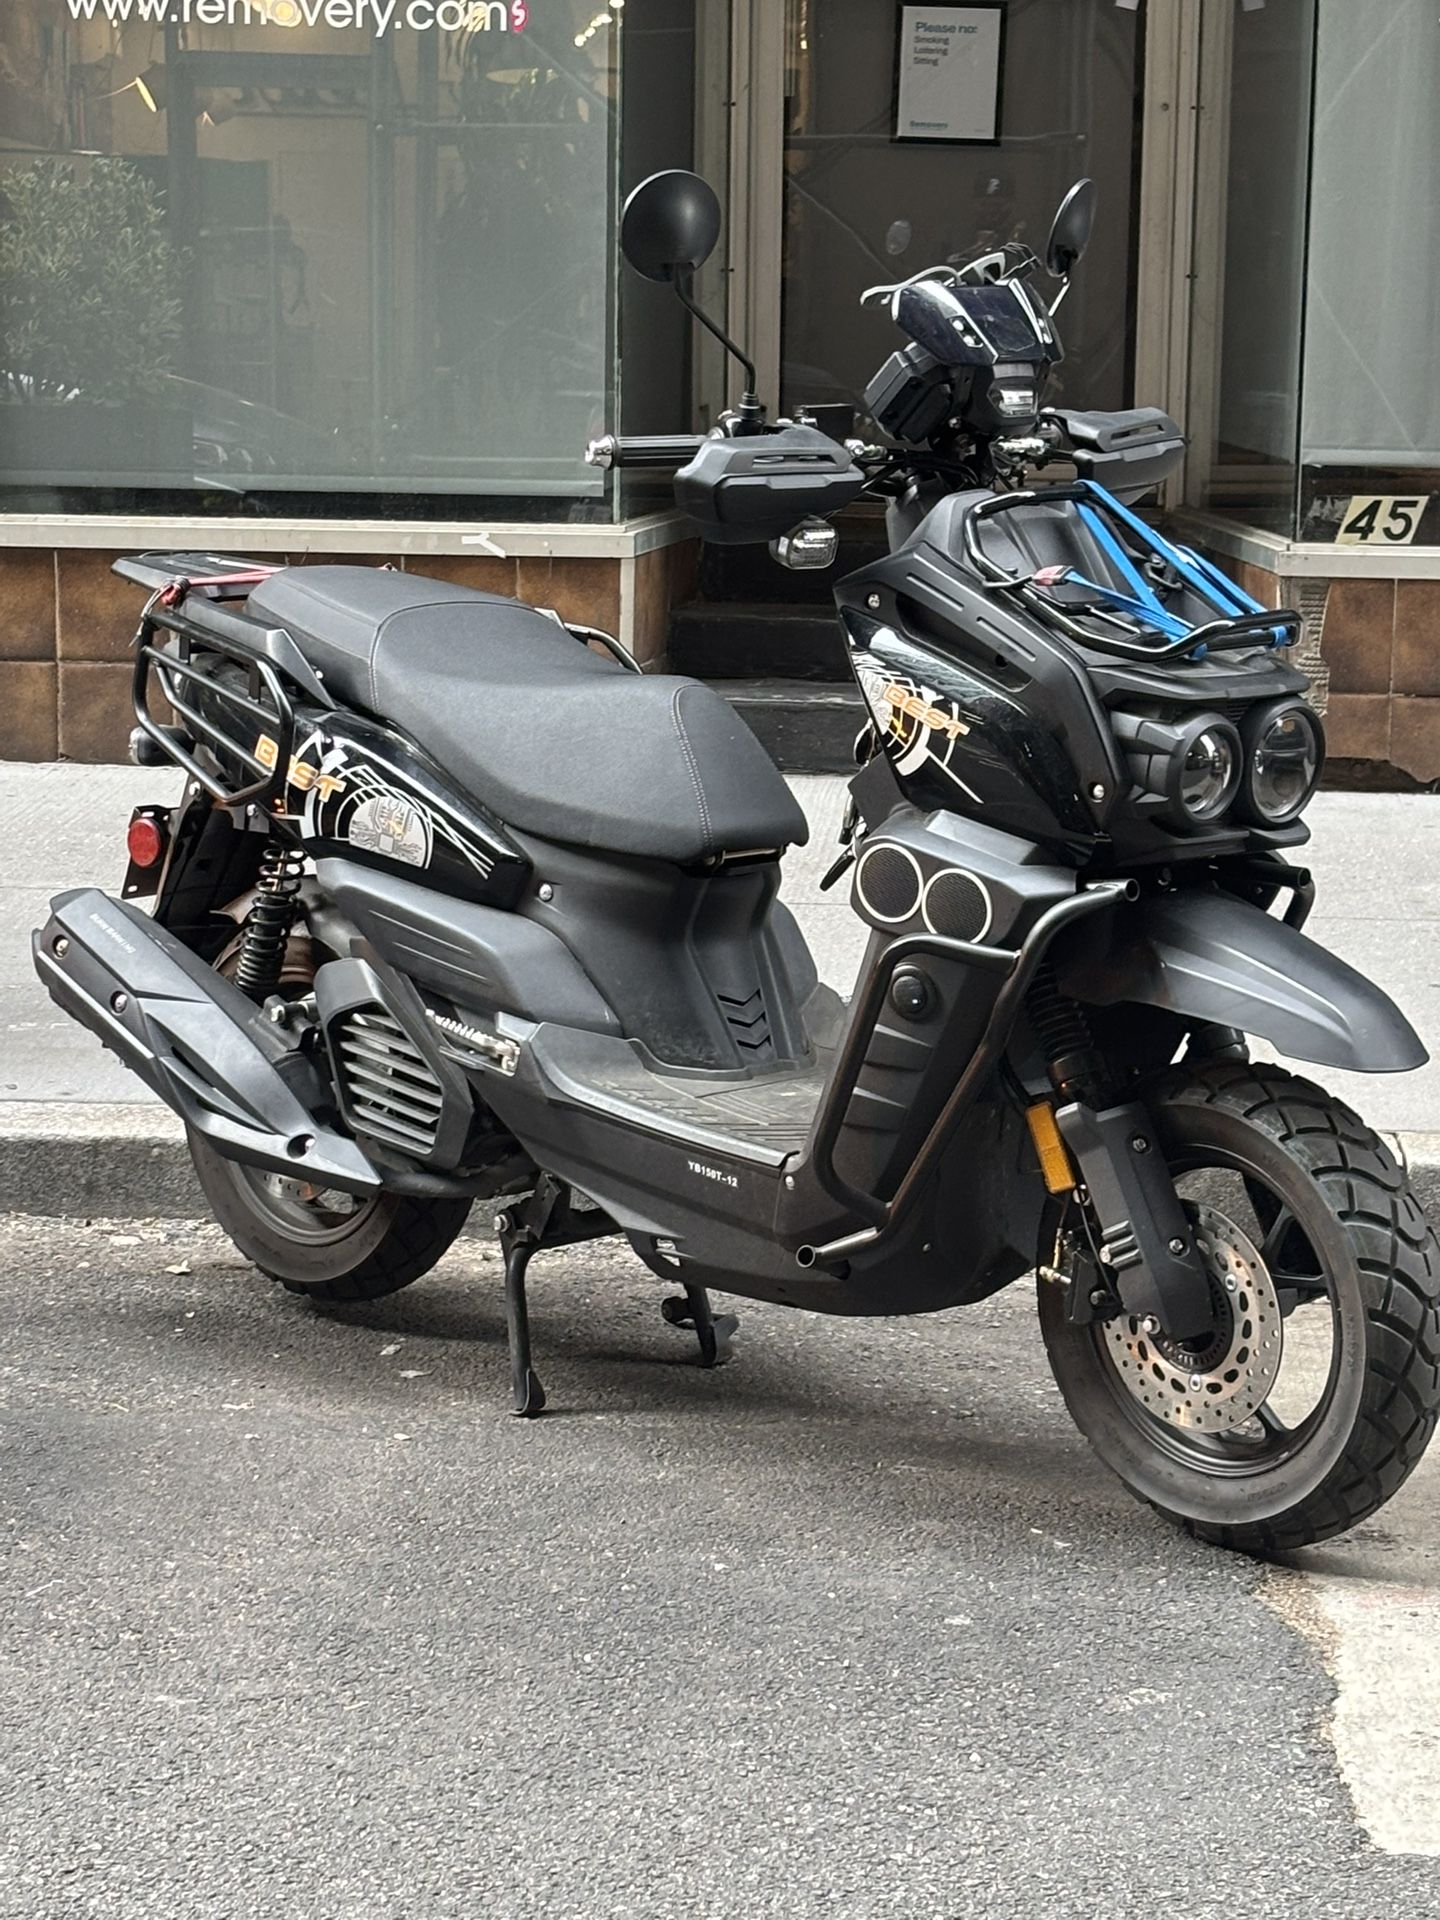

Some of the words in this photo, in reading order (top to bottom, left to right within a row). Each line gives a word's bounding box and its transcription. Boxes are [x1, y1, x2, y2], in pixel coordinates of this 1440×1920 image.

[914, 35, 950, 46] Smoking
[915, 21, 957, 33] Please
[958, 24, 978, 34] no:
[1343, 500, 1419, 541] 45
[883, 684, 971, 740] BEST
[688, 1160, 738, 1188] YB150T-12
